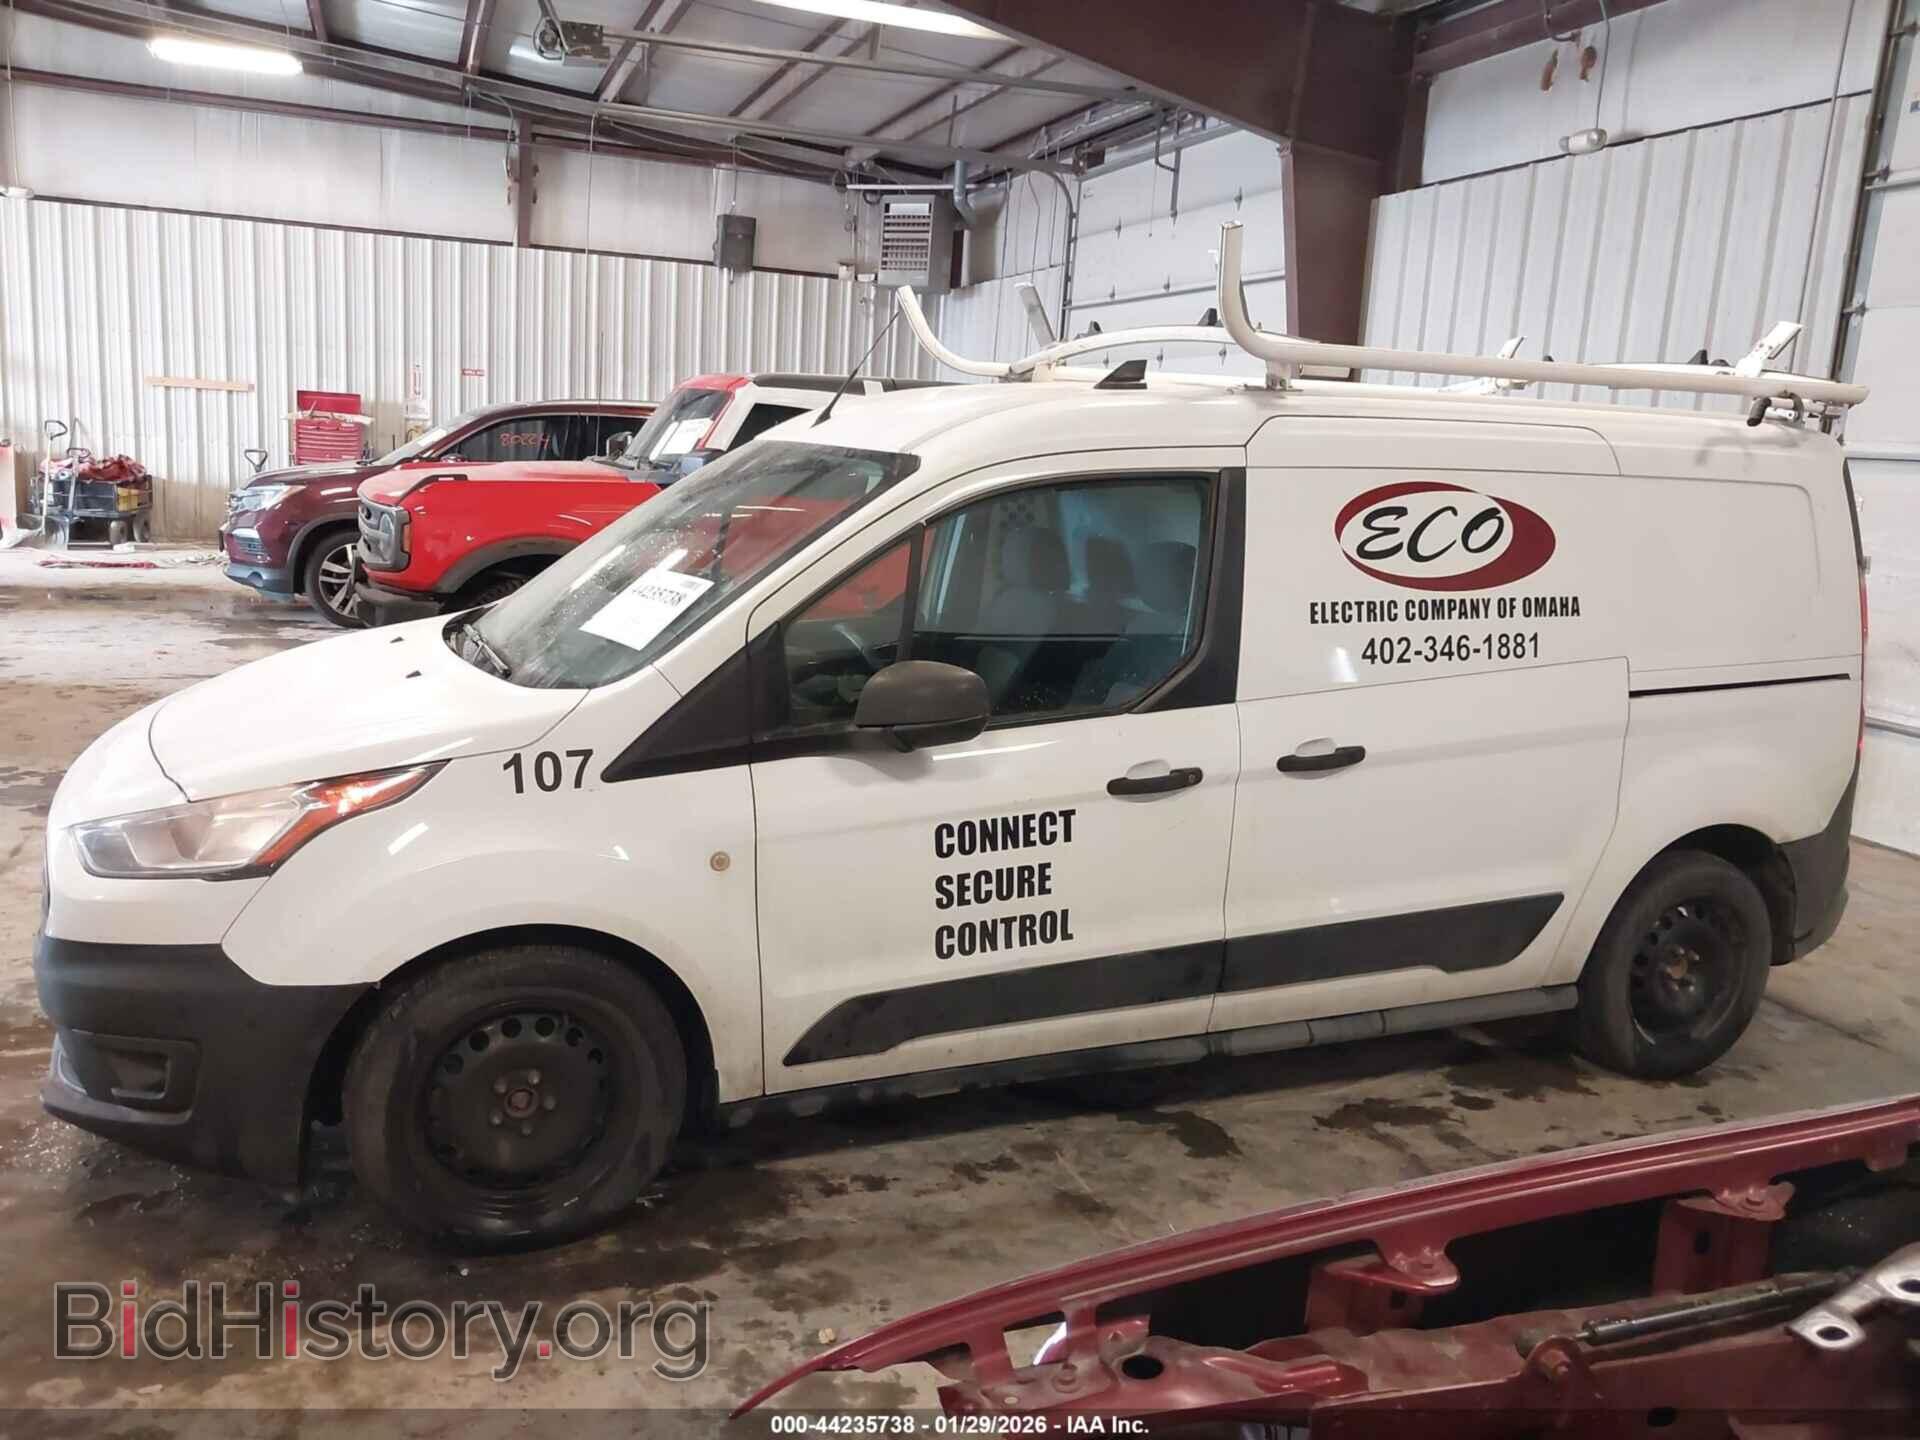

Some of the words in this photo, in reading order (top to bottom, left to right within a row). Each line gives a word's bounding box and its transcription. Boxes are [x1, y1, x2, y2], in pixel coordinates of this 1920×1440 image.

[1356, 505, 1505, 563] ECO
[1309, 600, 1399, 625] ELECTRIC
[1404, 598, 1492, 622] COMPANY
[1497, 597, 1517, 619] OF
[1522, 596, 1581, 618] OMAHA
[1361, 631, 1540, 665] 402-346-1881
[503, 748, 594, 794] 107
[934, 808, 1077, 859] CONNECT
[935, 862, 1052, 910] SECURE
[935, 908, 1074, 960] CONTROL
